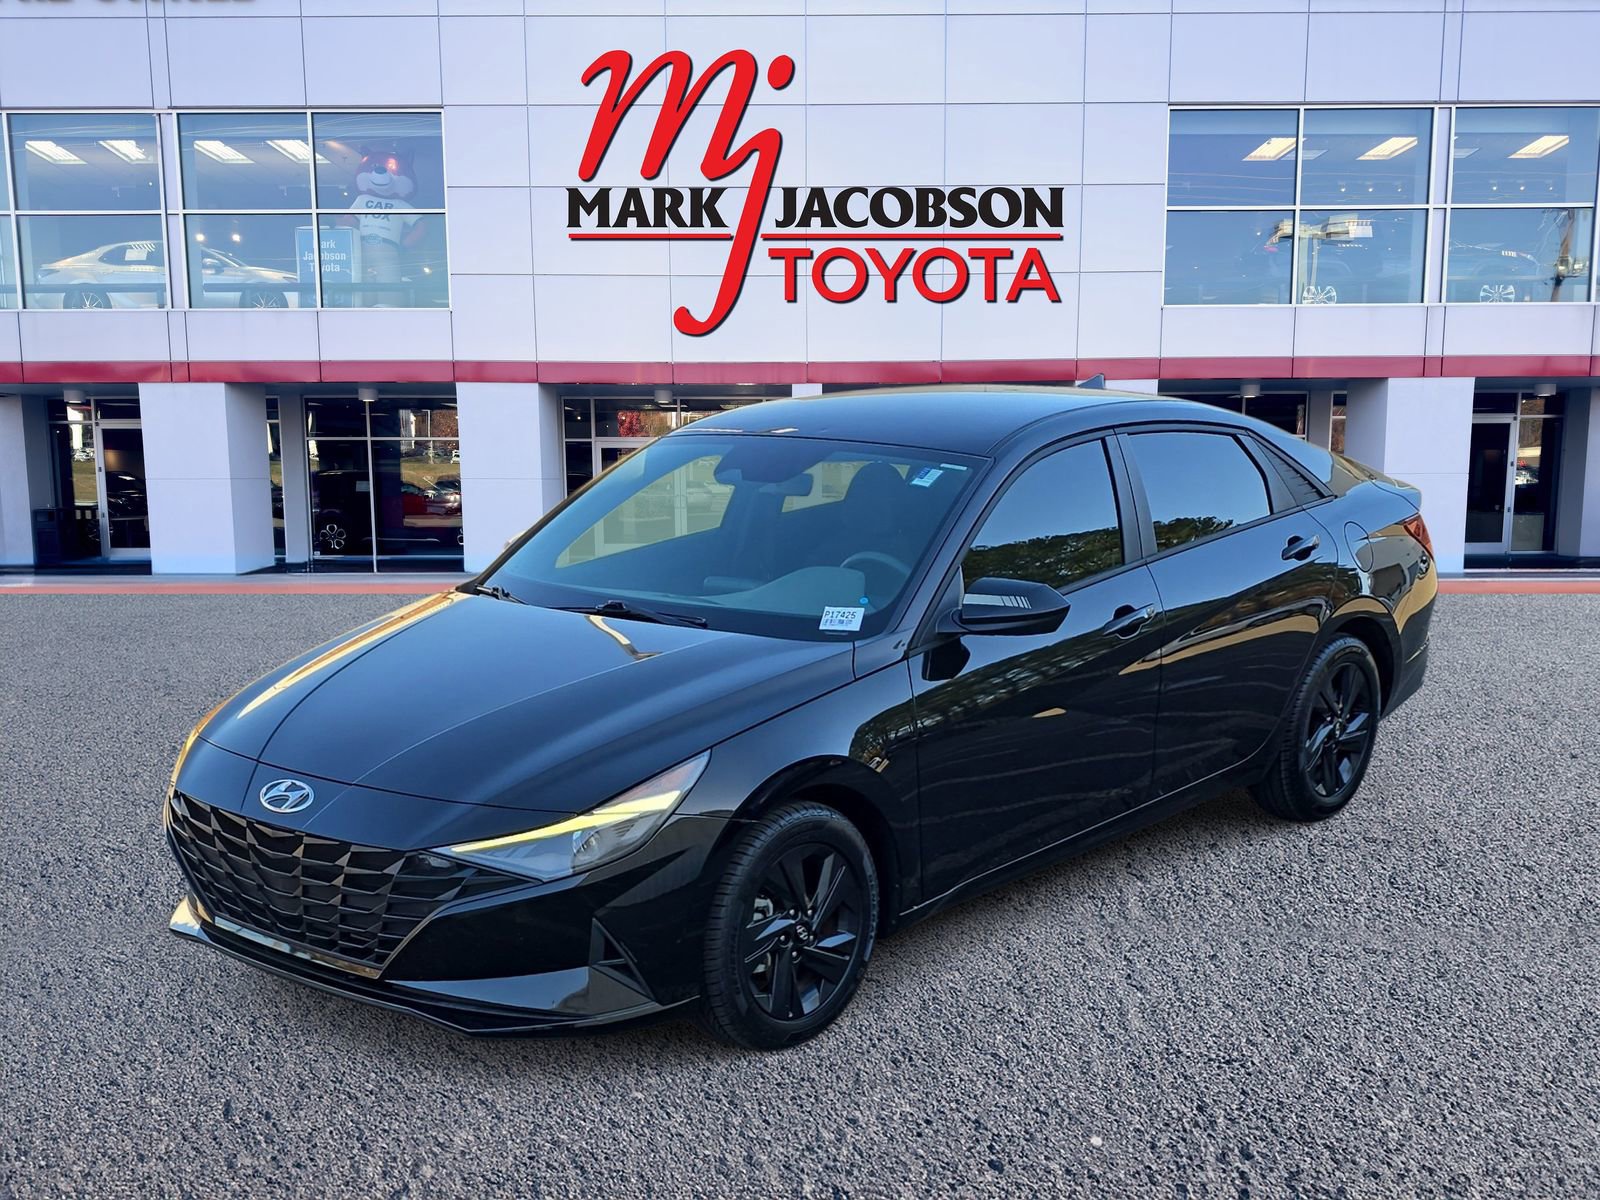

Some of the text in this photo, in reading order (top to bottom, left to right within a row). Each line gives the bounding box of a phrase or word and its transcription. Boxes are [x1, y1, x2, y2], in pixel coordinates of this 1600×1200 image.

[566, 187, 1065, 228] MARK JACOBSON
[318, 239, 336, 249] ark
[308, 262, 340, 273] Tyota
[768, 247, 1062, 304] TOYOTA
